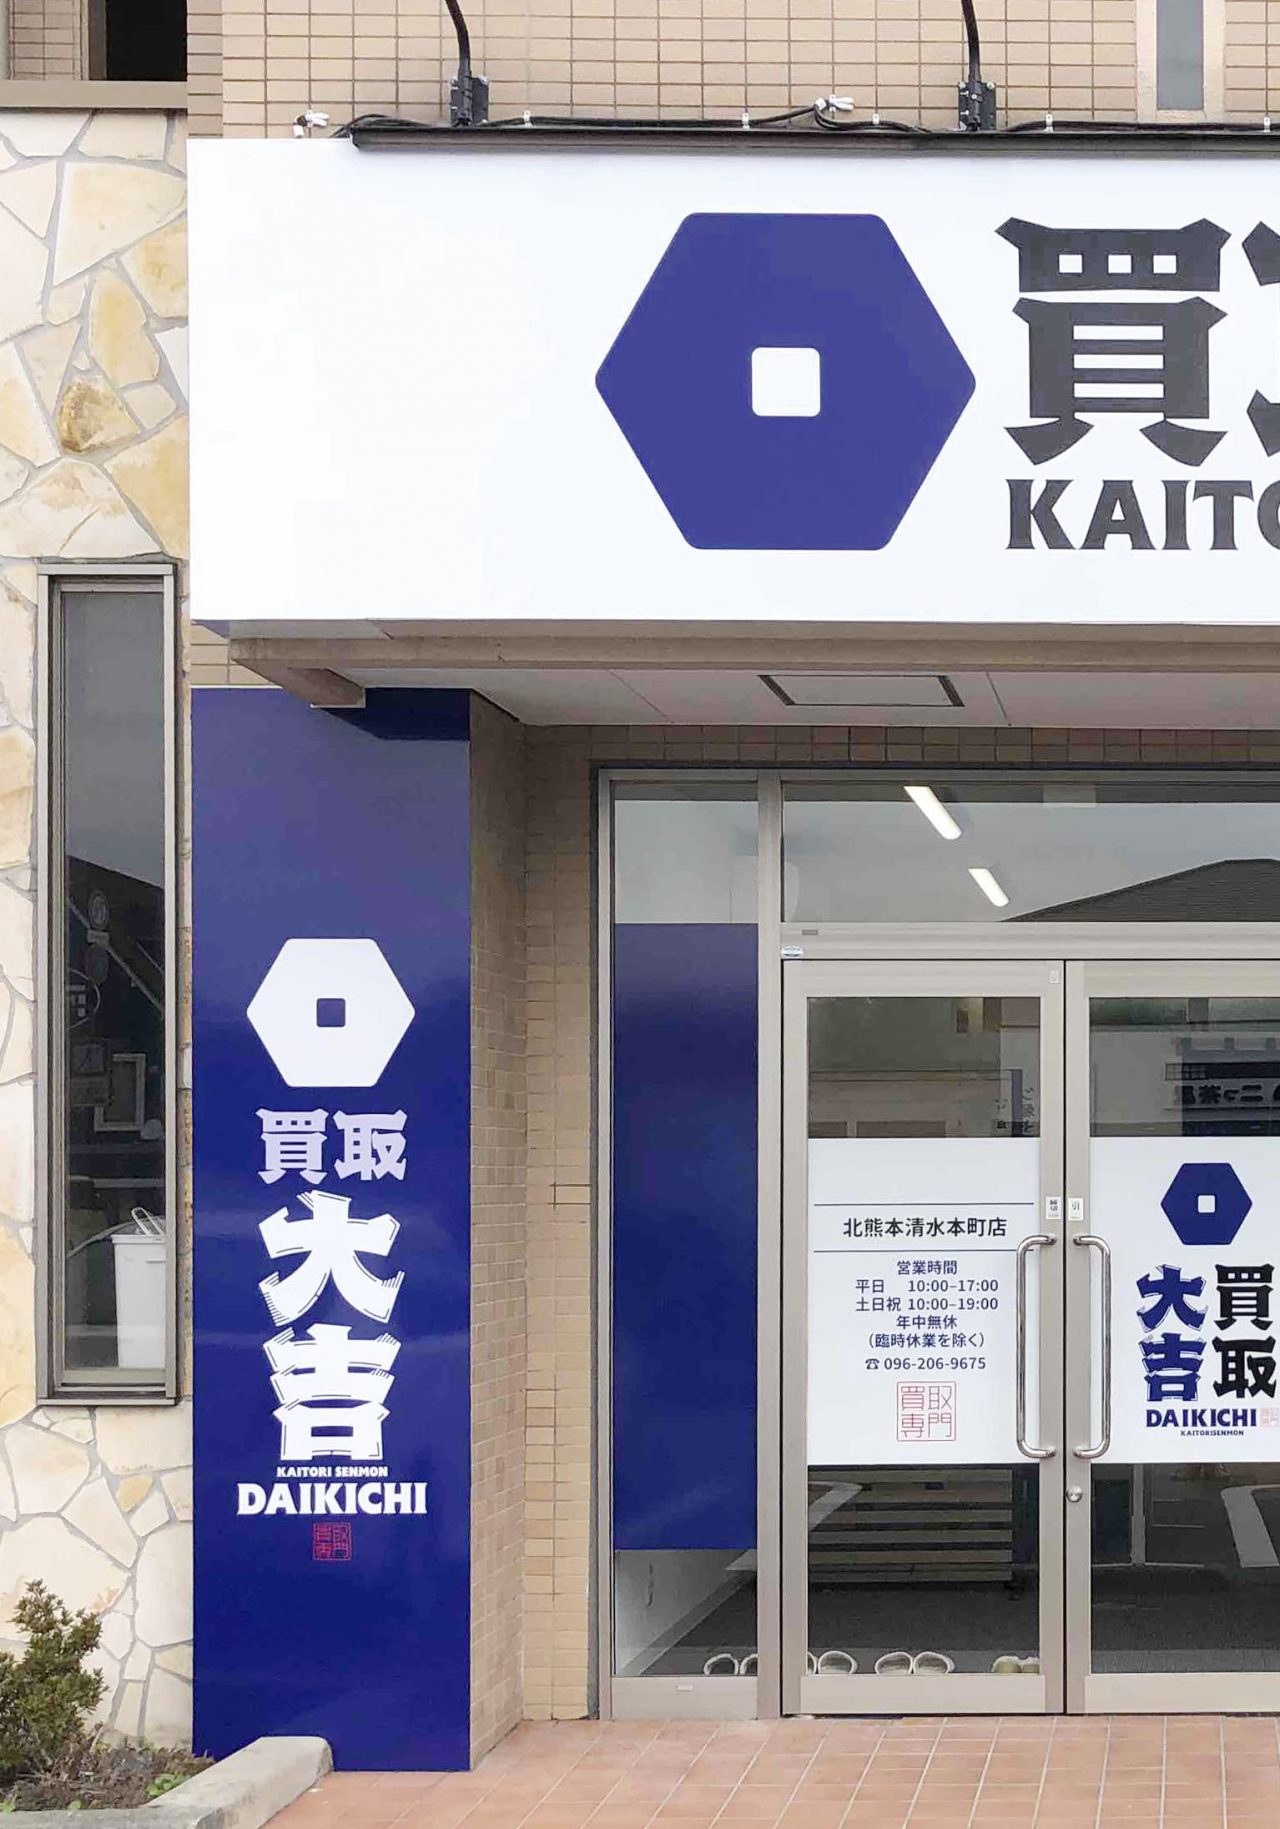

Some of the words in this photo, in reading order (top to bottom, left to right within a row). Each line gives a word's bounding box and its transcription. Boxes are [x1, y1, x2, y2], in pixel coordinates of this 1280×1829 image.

[256, 1109, 407, 1184] 買取
[843, 1217, 1007, 1238] 北熊本清水本町店
[897, 1260, 958, 1275] 営業時間
[855, 1279, 885, 1293] 平日
[855, 1297, 901, 1312] 土日祝
[259, 1190, 405, 1460] 大吉
[896, 1315, 958, 1330] 年中無休
[1213, 1264, 1277, 1399] 買取
[1136, 1264, 1209, 1402] 大吉
[884, 1357, 986, 1370] 096-206-9675
[1146, 1409, 1257, 1428] DAIKICHI
[276, 1466, 332, 1478] KAITORI
[335, 1466, 389, 1478] SENMON
[237, 1482, 428, 1515] DAIKICHI
